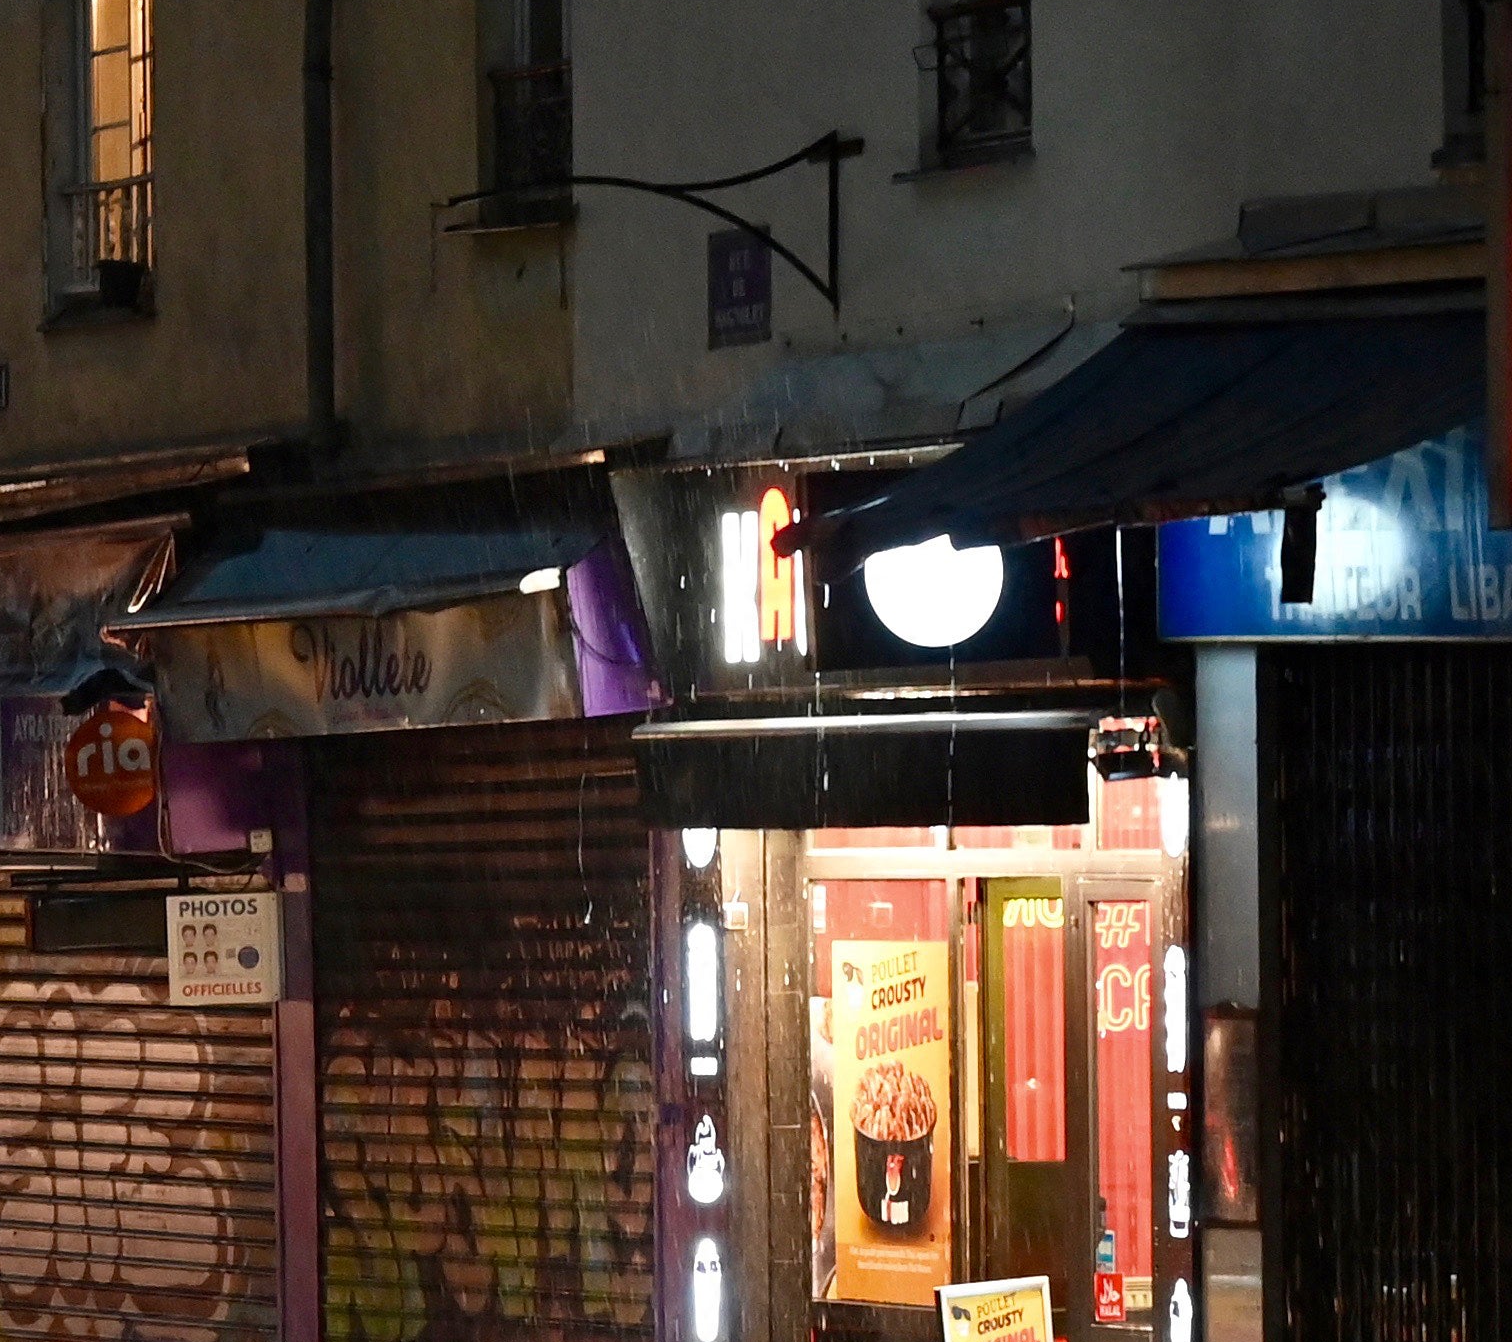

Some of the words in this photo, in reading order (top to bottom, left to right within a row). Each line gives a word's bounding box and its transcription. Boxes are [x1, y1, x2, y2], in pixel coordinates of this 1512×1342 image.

[77, 721, 152, 778] ria
[179, 899, 258, 918] PHOTOS
[871, 951, 918, 983] POULET
[182, 982, 263, 998] OFFICIELLES
[871, 975, 926, 1011] CROUSTY
[855, 1006, 944, 1061] ORIGINAL
[976, 1292, 1018, 1319] POULET
[977, 1308, 1025, 1336] CROUSTY
